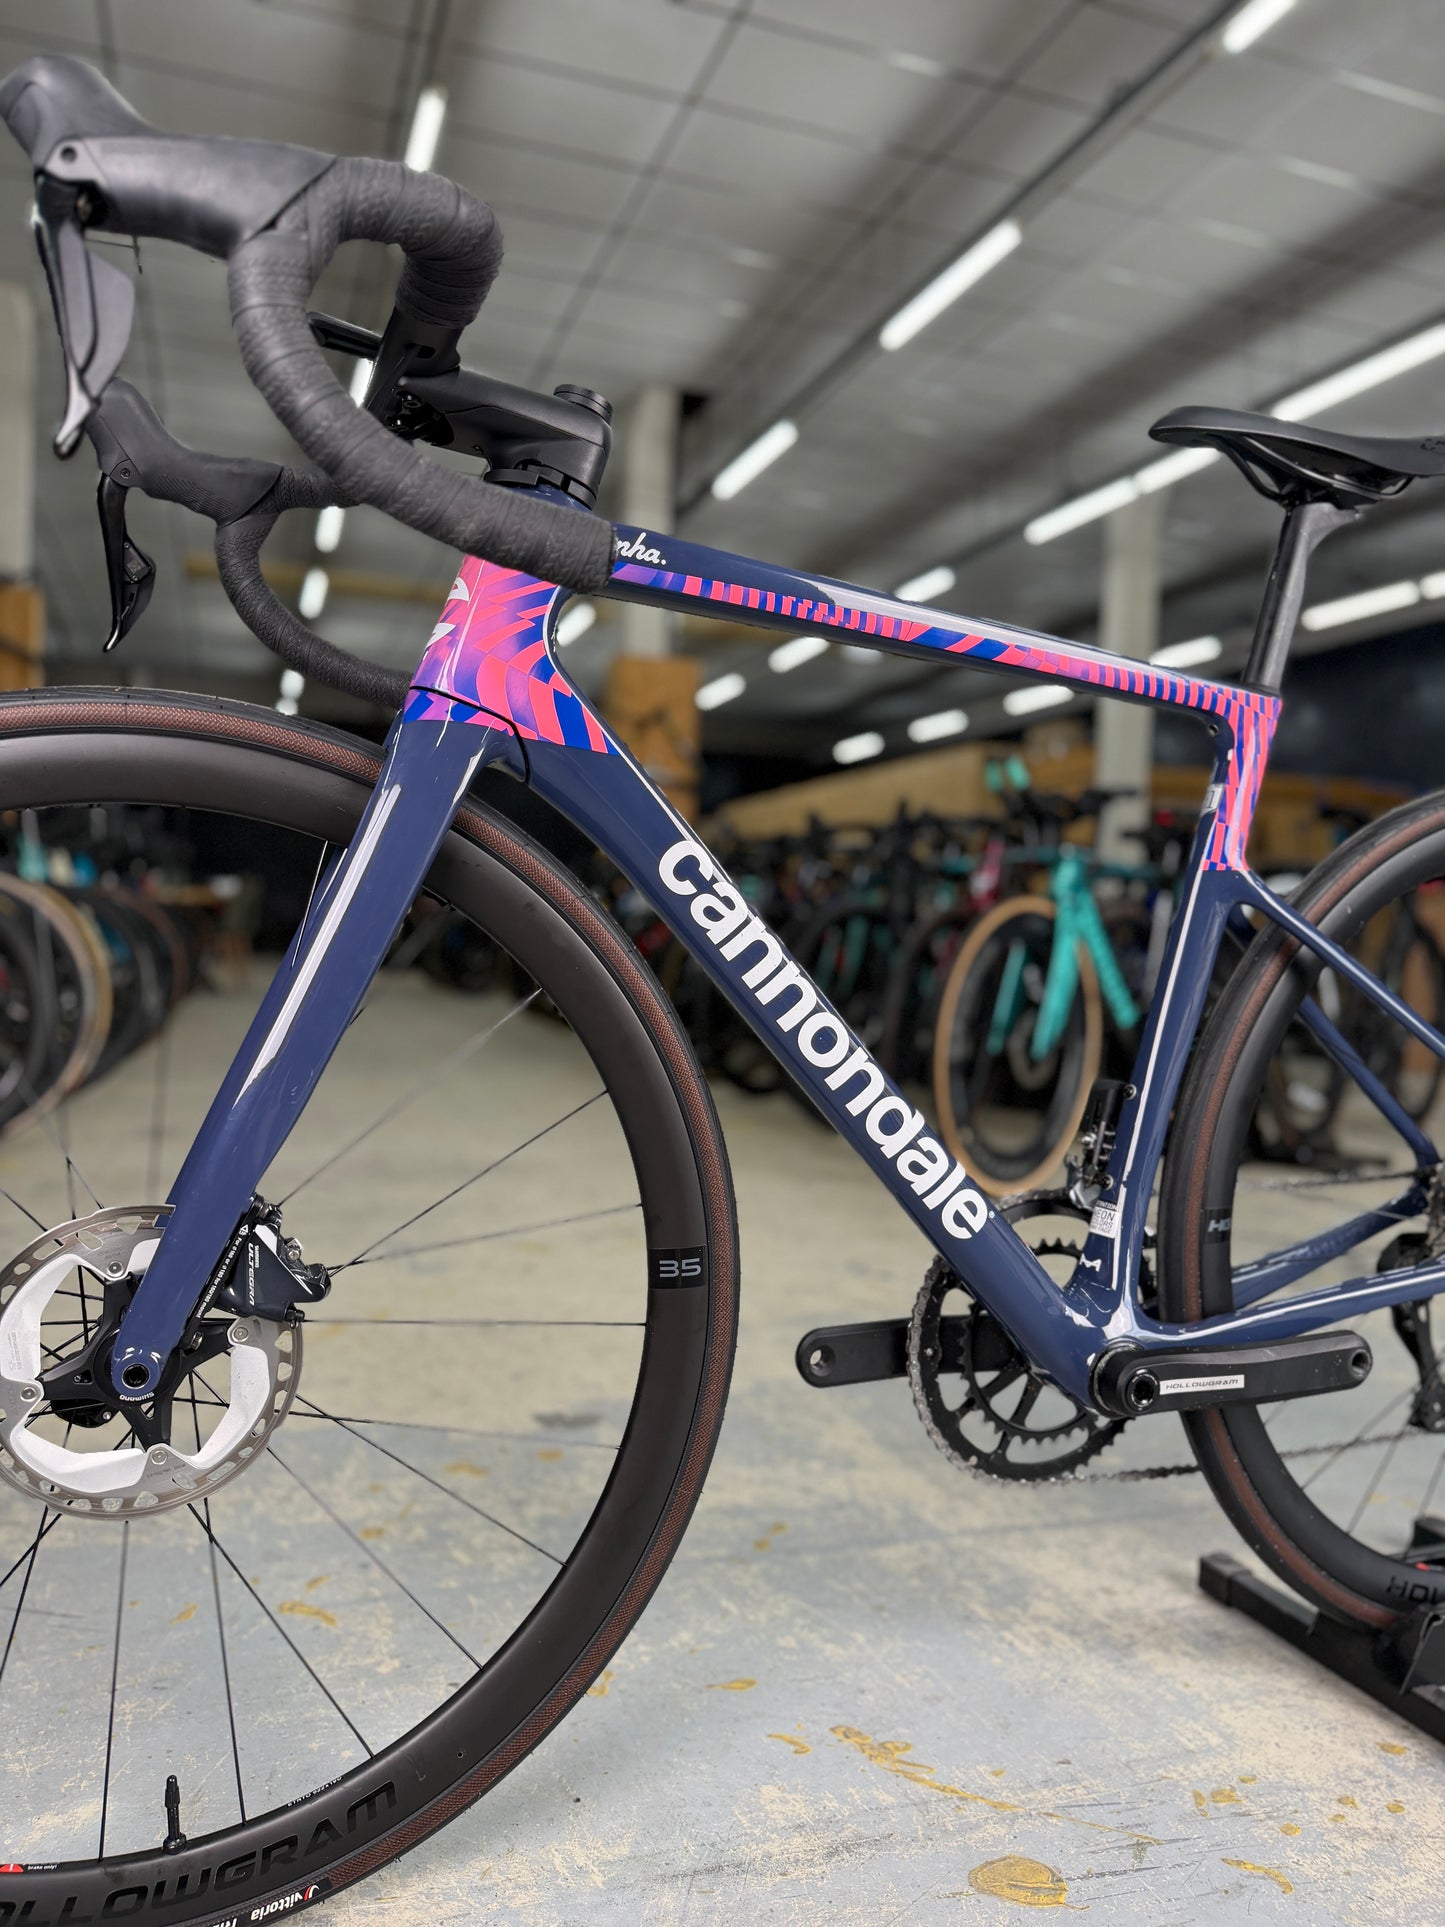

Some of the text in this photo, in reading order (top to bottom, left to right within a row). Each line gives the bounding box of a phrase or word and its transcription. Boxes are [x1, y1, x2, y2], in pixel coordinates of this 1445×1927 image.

[658, 840, 988, 1240] cannondale
[248, 1242, 256, 1306] ULTEGRA
[659, 1257, 702, 1278] 35
[1165, 1379, 1239, 1390] HOLLOWGRAM
[250, 1892, 304, 1920] vittoria
